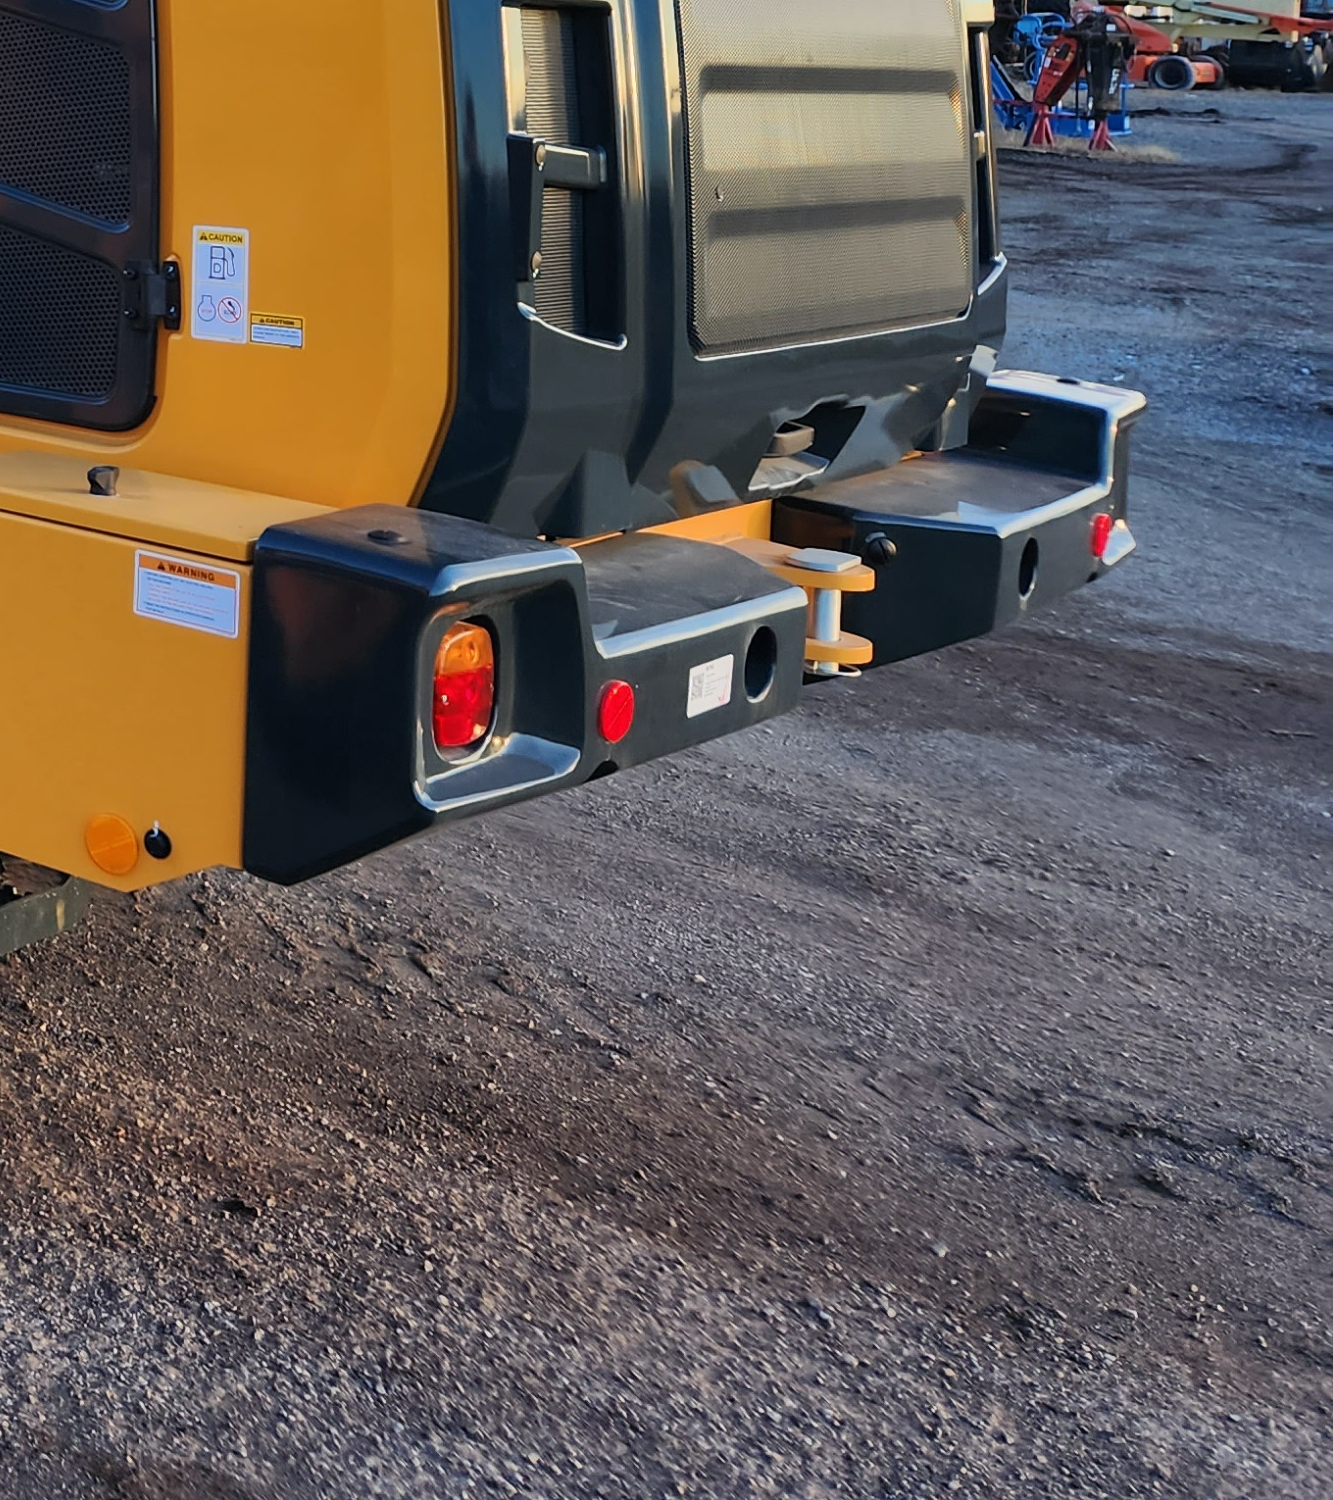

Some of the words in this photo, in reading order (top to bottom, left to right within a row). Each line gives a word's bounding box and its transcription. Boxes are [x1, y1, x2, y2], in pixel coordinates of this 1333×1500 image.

[208, 232, 243, 243] CAUTION
[265, 317, 295, 326] CAUTION
[168, 564, 215, 581] WARNING
